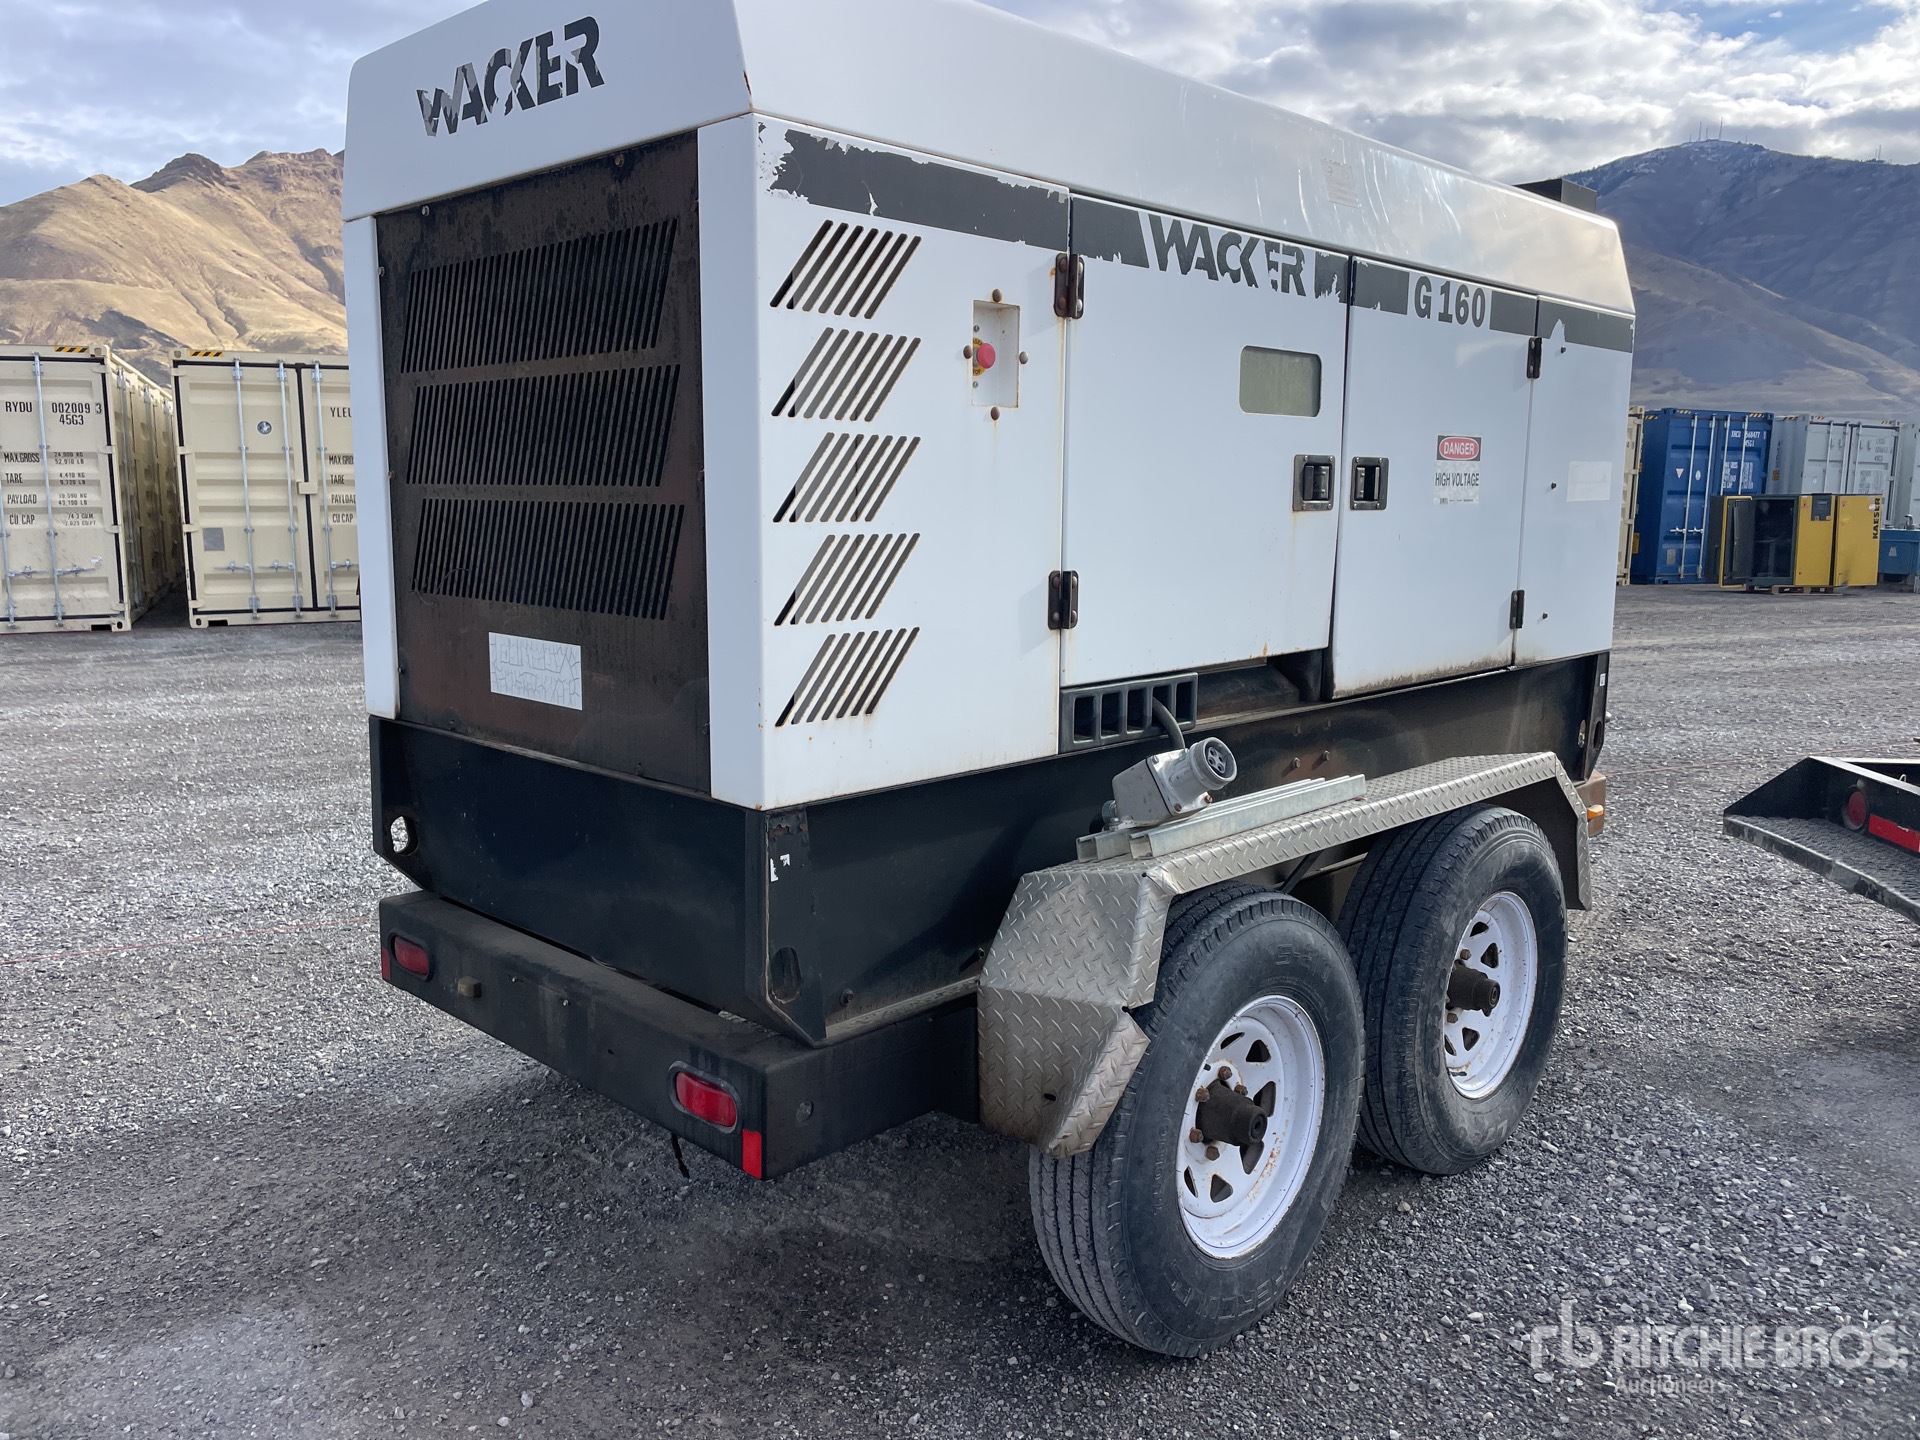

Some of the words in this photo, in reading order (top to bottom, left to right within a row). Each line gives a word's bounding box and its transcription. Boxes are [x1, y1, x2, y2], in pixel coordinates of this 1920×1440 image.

[416, 15, 605, 137] WACKER
[1148, 213, 1306, 297] WACKER
[5, 401, 33, 413] RYDU
[51, 402, 91, 414] 002009
[95, 402, 103, 414] 3
[59, 414, 84, 425] 45G3
[1443, 441, 1475, 455] DANGER
[5, 473, 23, 484] TARE
[330, 475, 345, 485] TARE
[1434, 472, 1450, 487] HIGH
[1452, 472, 1480, 487] VOLTAGE
[7, 494, 38, 505] PAYLOAD
[1872, 497, 1881, 539] KAESER
